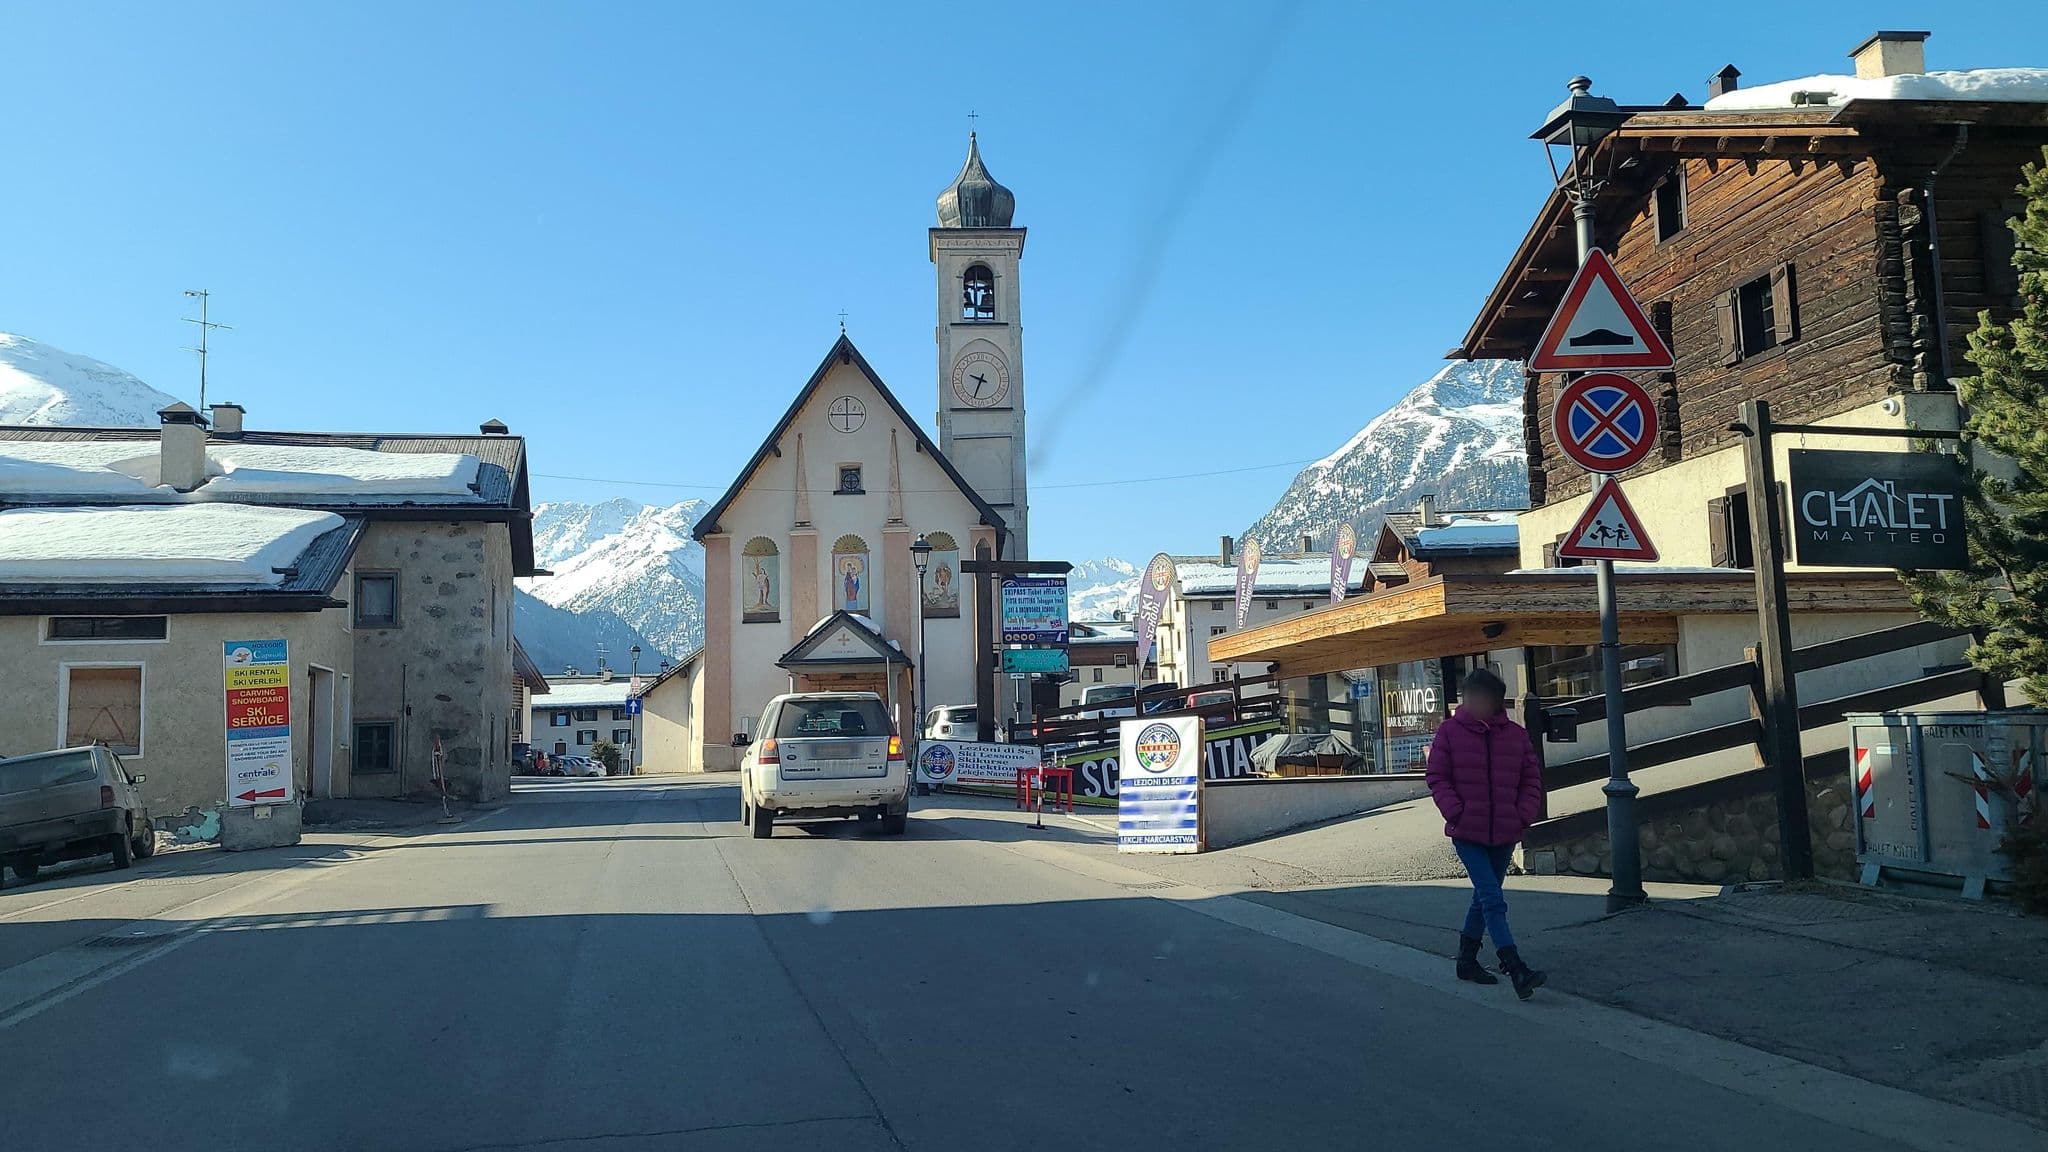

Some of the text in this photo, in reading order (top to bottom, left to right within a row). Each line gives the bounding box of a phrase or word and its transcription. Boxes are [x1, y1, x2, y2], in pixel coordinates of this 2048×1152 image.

[1802, 490, 1953, 529] CHALET
[1813, 531, 1945, 544] MATTEO
[1141, 593, 1154, 622] SKI
[1146, 601, 1160, 640] SCHOOL
[240, 689, 276, 697] CARVING
[1386, 682, 1435, 714] miwine
[232, 696, 285, 705] SNOWBOARD
[246, 706, 267, 716] SKI
[232, 715, 284, 727] SERVICE
[1386, 716, 1397, 727] BAR
[959, 745, 1000, 753] Lezioni
[1017, 747, 1034, 755] Sci
[958, 757, 1009, 765] Skikurse
[980, 752, 1025, 760] Lessons
[238, 768, 277, 778] centrale
[957, 769, 985, 777] Lekcje
[1133, 777, 1183, 786] LEZIONI DI SCI
[1144, 835, 1195, 844] NARCIARSTWA
